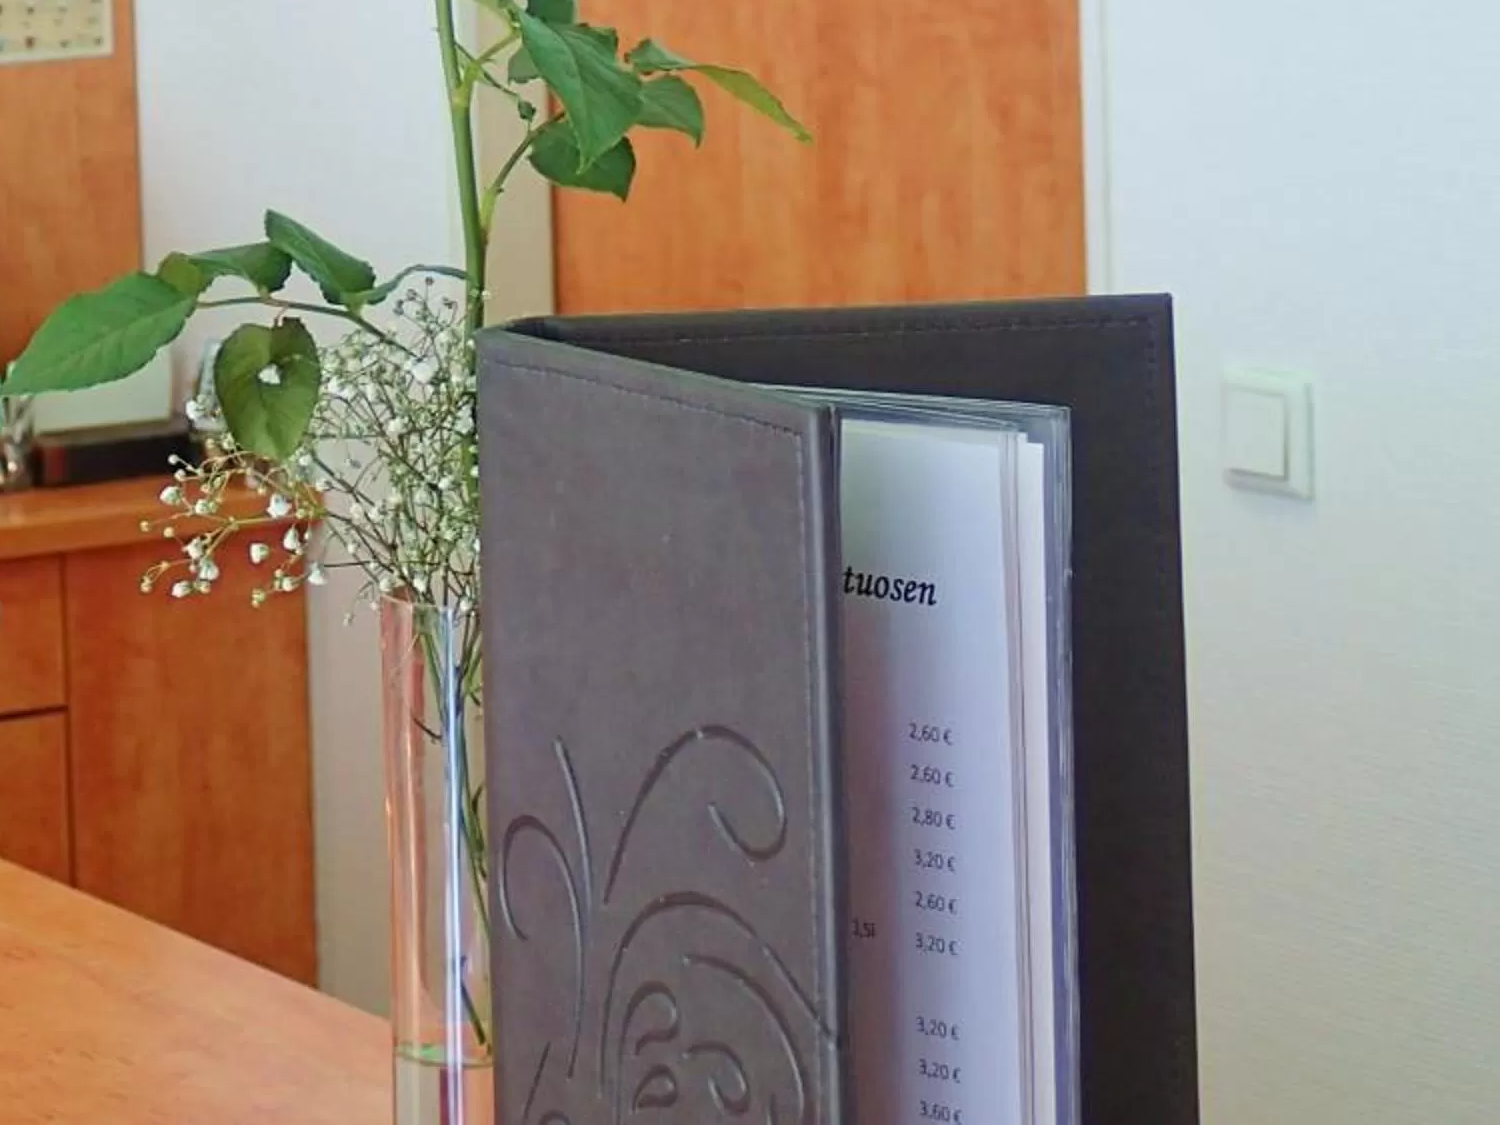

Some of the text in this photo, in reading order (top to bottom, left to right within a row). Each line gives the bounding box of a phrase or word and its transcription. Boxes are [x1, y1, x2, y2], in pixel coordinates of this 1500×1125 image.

[842, 566, 937, 606] tuosen
[908, 722, 940, 743] 2,60
[910, 763, 941, 785] 2,60
[911, 806, 943, 828] 2,80
[913, 848, 944, 870] 3,20
[915, 890, 945, 912] 2,60
[915, 931, 946, 954] 3,20
[915, 1015, 948, 1039] 3,20
[919, 1058, 949, 1080] 3,20
